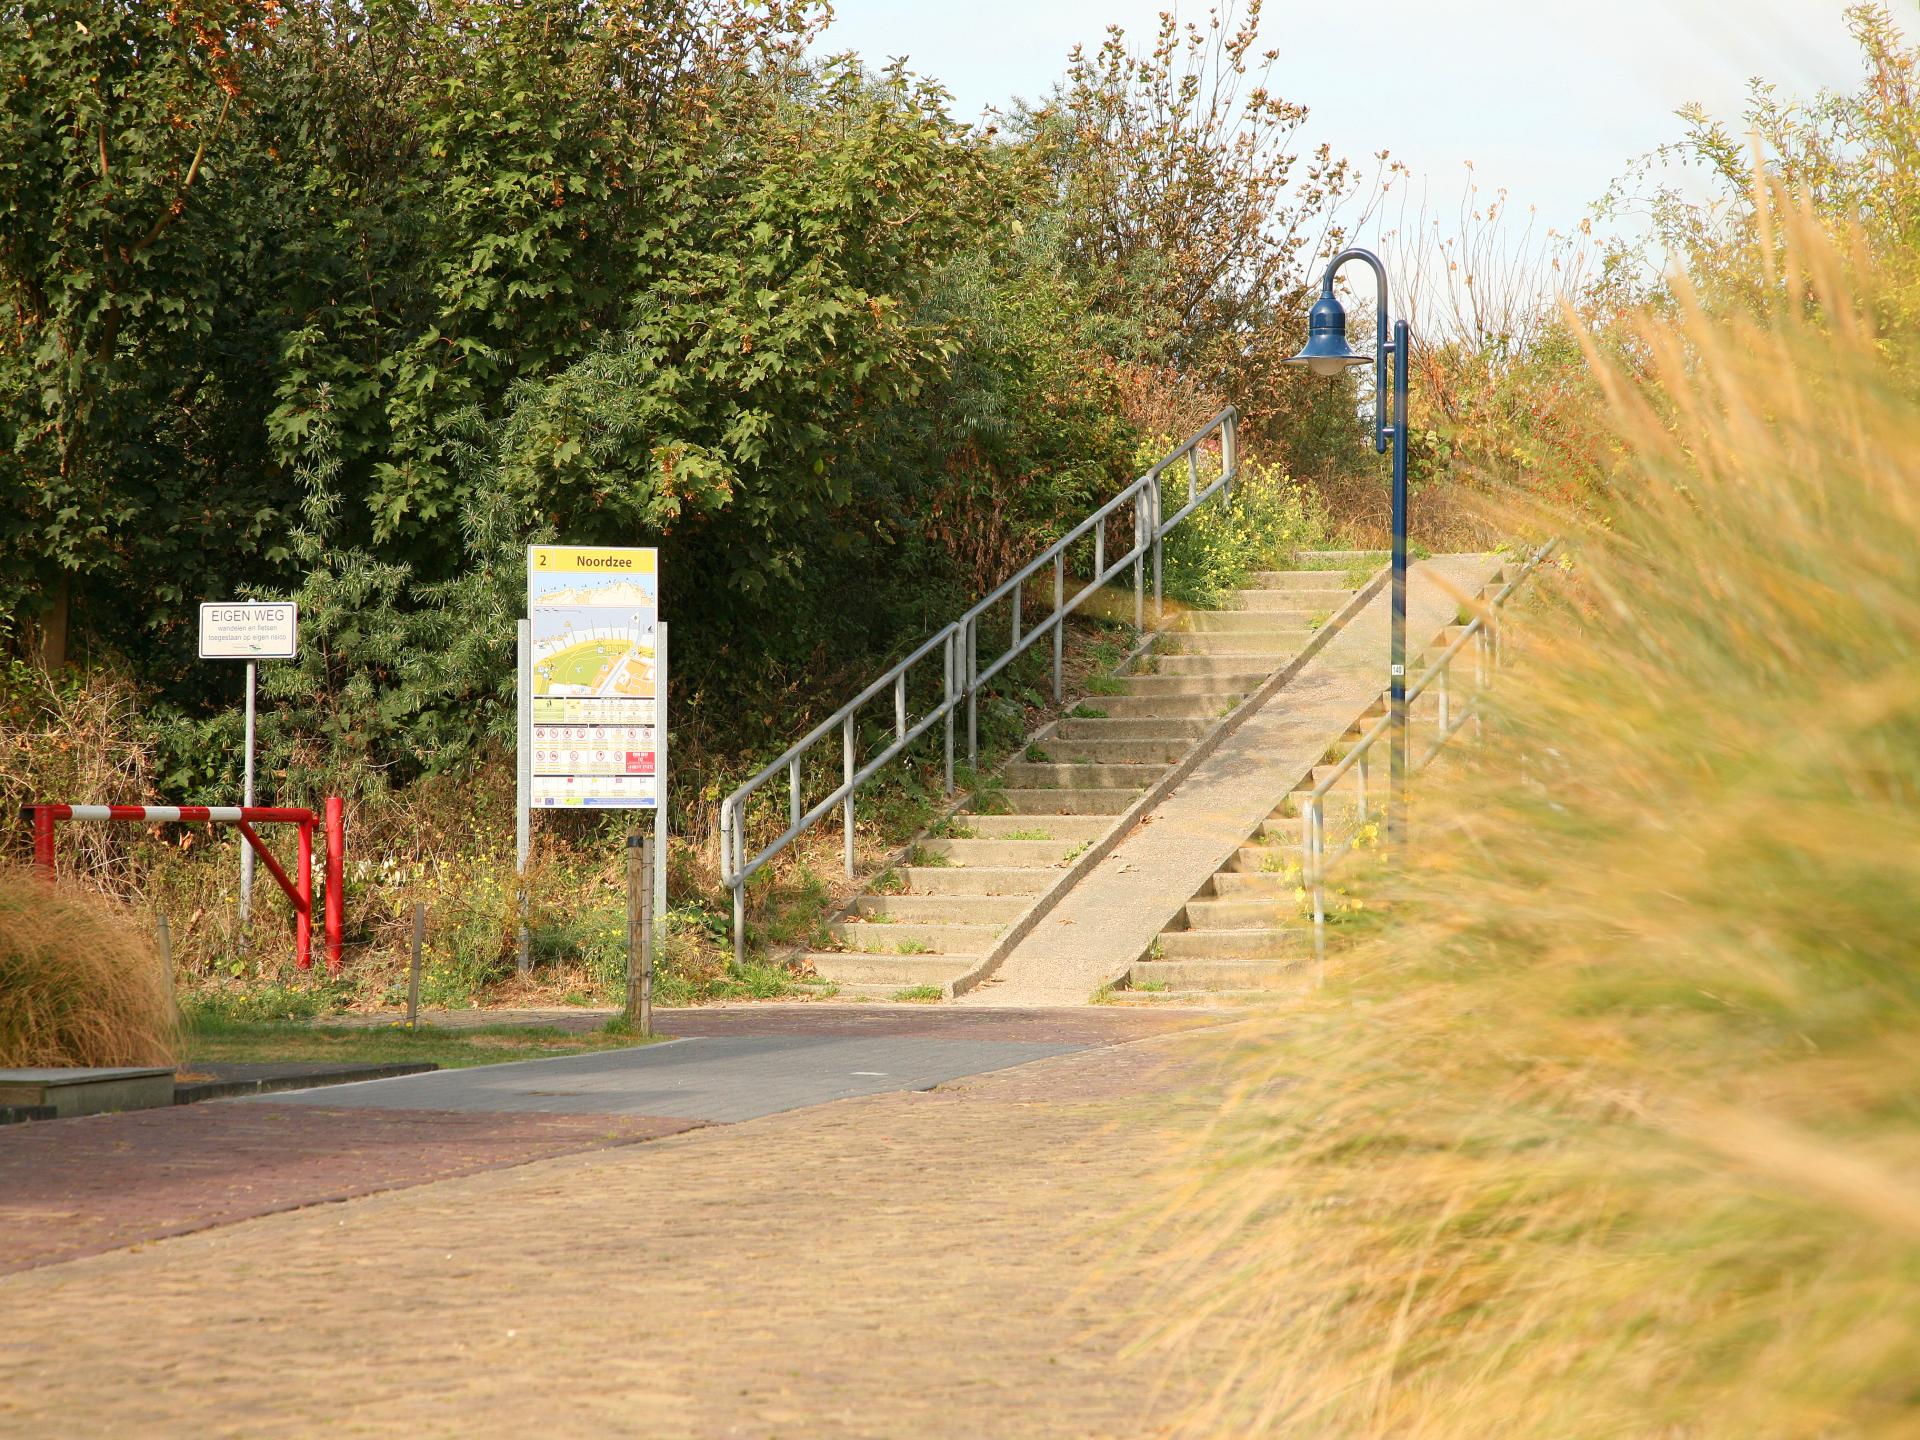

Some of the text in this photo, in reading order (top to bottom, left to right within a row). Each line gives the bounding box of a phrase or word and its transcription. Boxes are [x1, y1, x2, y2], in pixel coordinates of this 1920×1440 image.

[539, 555, 547, 566] 2
[577, 555, 632, 568] Noordzee
[211, 609, 285, 622] EIGEN WEG
[217, 624, 247, 632] wandelen
[208, 634, 242, 642] toegestaan
[243, 634, 251, 642] op
[252, 634, 269, 642] eigen
